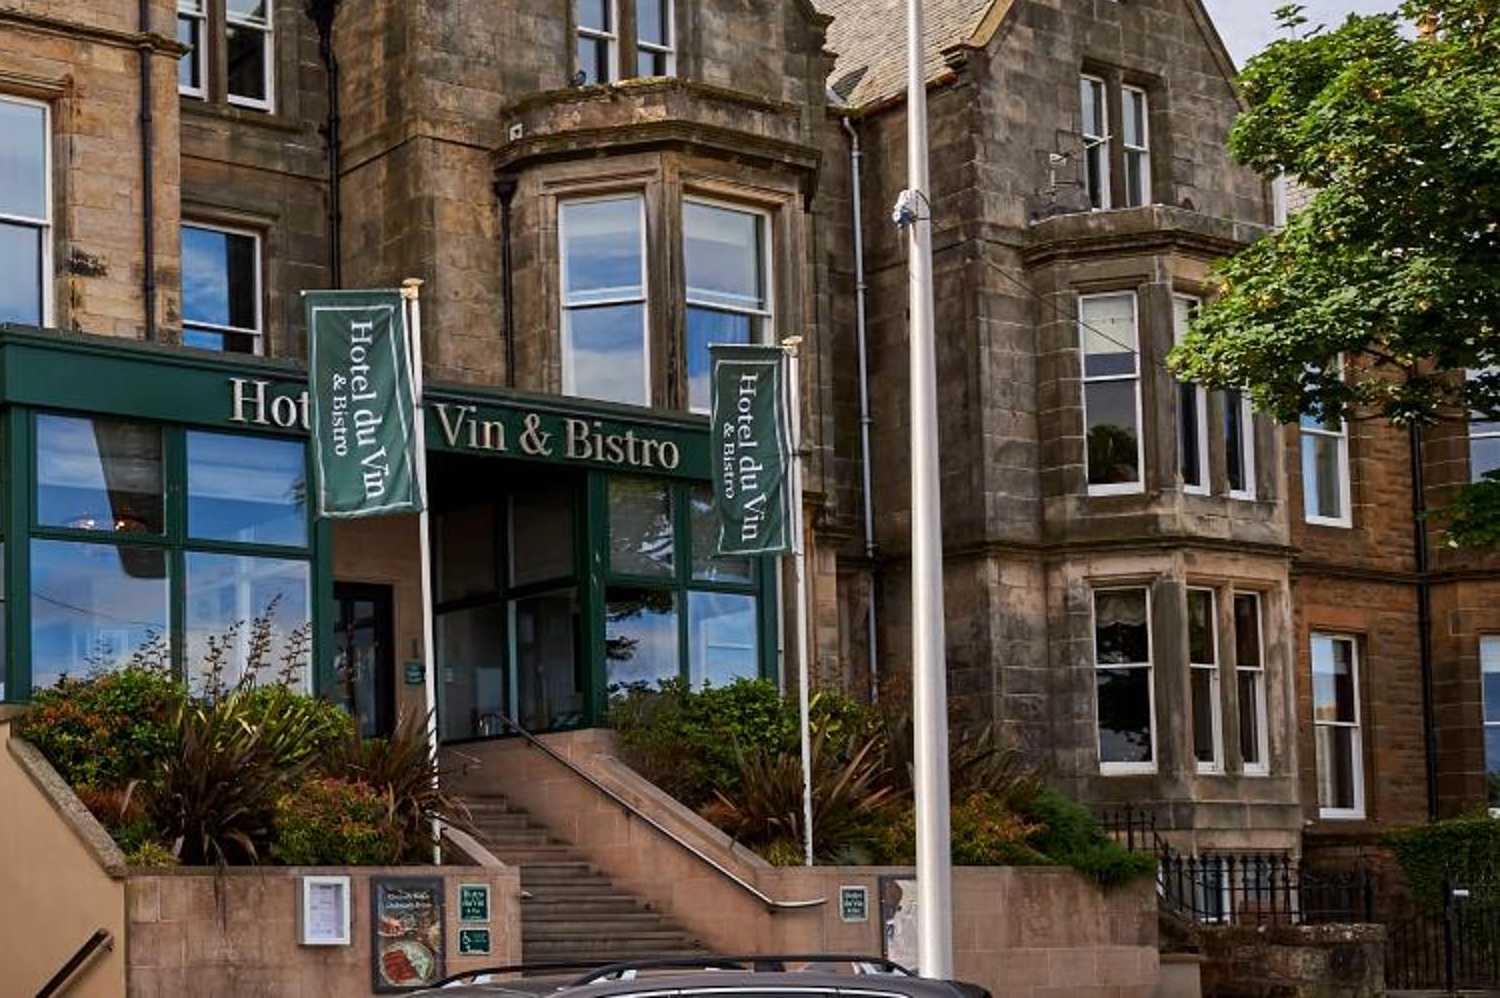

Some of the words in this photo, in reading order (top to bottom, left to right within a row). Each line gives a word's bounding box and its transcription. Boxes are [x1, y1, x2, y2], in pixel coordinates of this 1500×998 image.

[332, 373, 347, 391] &
[350, 320, 377, 402] Hotel
[229, 377, 310, 430] Hot
[432, 404, 507, 452] Vin
[518, 413, 553, 457] &
[564, 418, 680, 470] Bistro
[332, 395, 348, 457] Bistro
[353, 408, 382, 446] du
[723, 422, 735, 438] &
[737, 372, 759, 448] Hotel
[360, 446, 390, 500] Vin
[723, 442, 735, 500] Bistro
[739, 455, 763, 491] du
[741, 492, 767, 542] Vin
